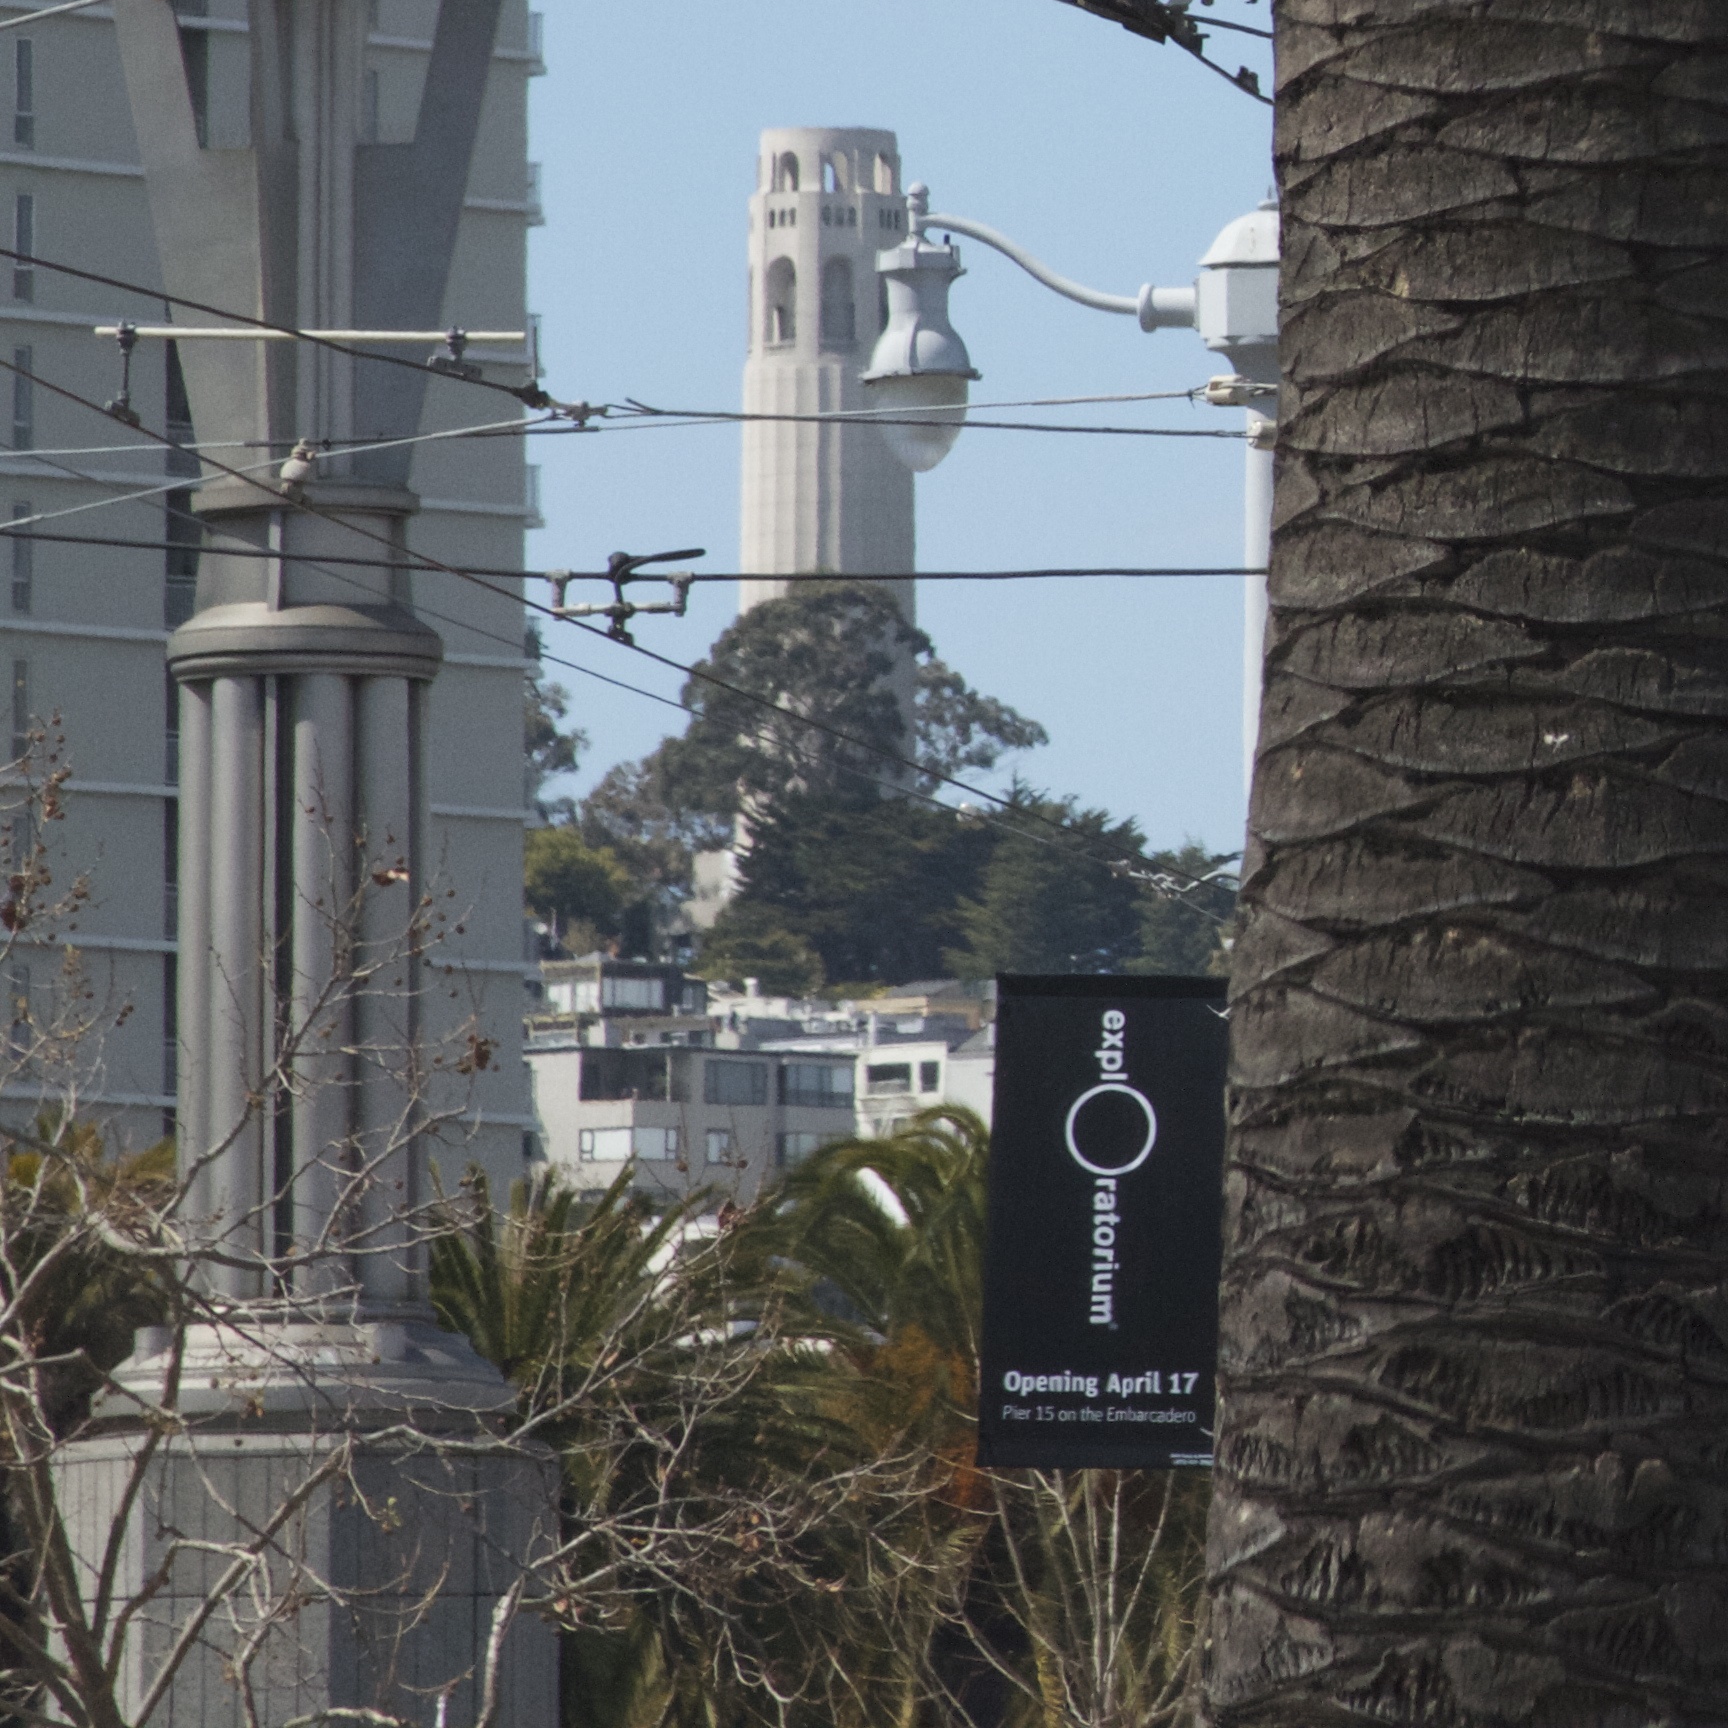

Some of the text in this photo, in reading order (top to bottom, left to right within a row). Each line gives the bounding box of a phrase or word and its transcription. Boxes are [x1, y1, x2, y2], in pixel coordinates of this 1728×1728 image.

[1003, 1369, 1200, 1398] Opening April 17
[1002, 1405, 1197, 1423] Pier 15 on the Embarcadero
